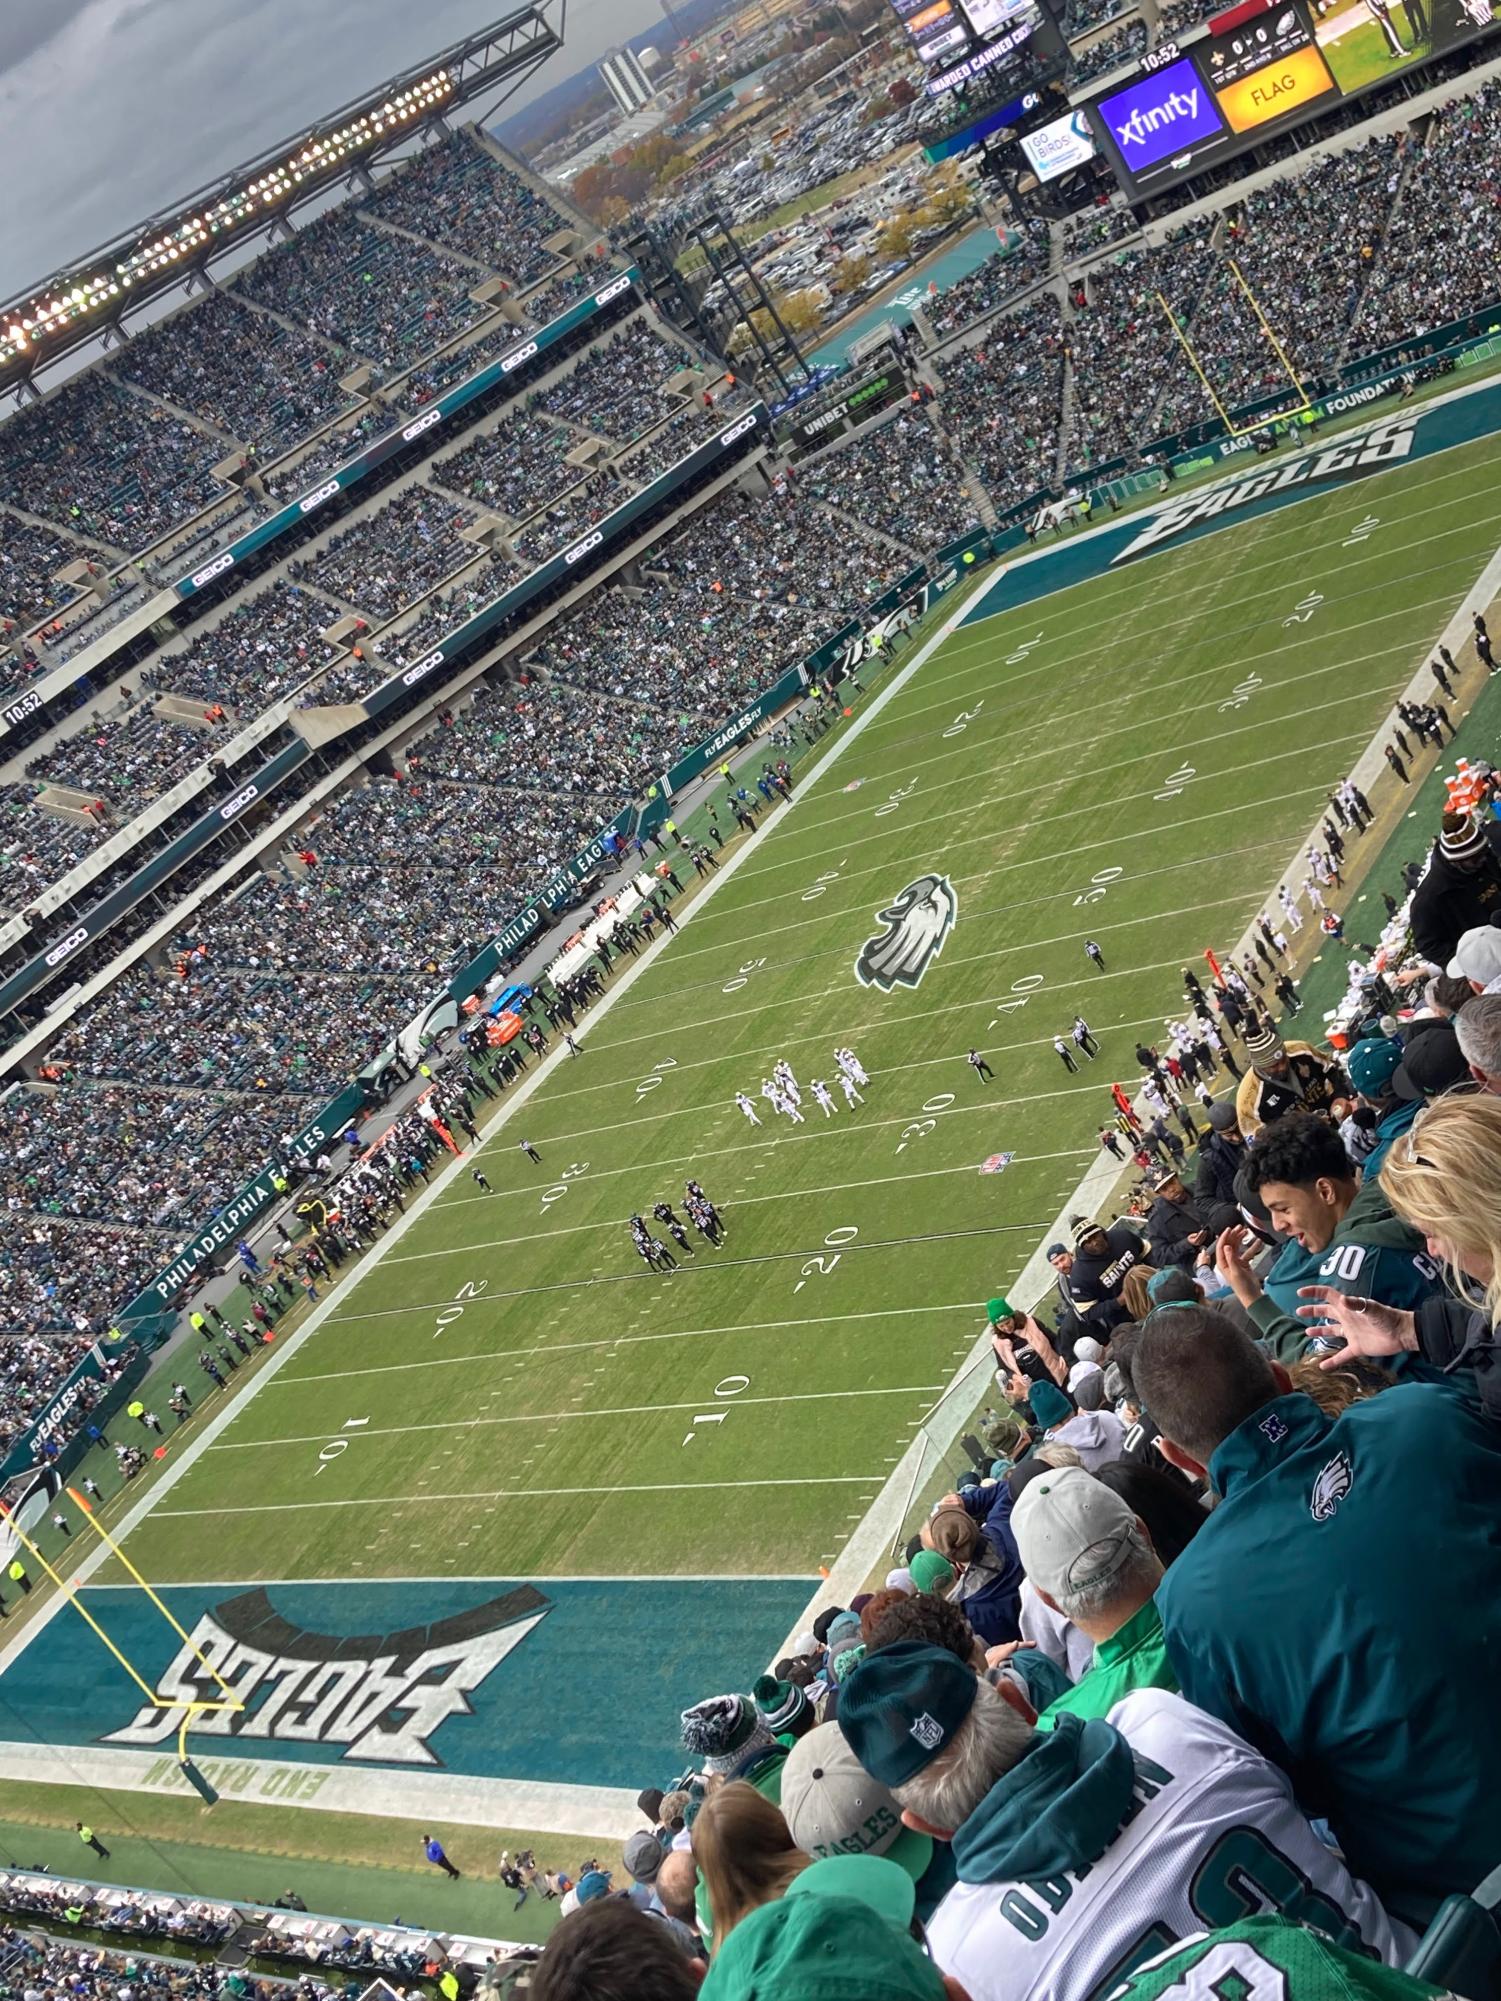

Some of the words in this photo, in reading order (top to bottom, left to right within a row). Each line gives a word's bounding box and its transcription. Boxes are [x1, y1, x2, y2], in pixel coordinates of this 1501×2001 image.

[970, 38, 1014, 72] CANNED
[1139, 43, 1181, 72] 10:52
[1231, 40, 1244, 55] 0
[1255, 26, 1268, 42] 0
[1251, 75, 1297, 107] FLAG
[1116, 88, 1199, 146] xfinity
[1032, 133, 1049, 148] GO
[595, 275, 632, 306] GEICO
[500, 342, 538, 373] GEICO
[401, 409, 442, 442] GEICO
[719, 414, 758, 447] GEICO
[802, 401, 850, 437] UNIBET
[299, 479, 341, 513] GEICO
[1109, 405, 1440, 565] EAGLES
[563, 531, 604, 566] GEICO
[1340, 516, 1381, 549] 10
[190, 553, 235, 588] GEICO
[1281, 594, 1325, 628] 20
[401, 651, 444, 686] GEICO
[4, 692, 44, 727] 10:52
[1217, 678, 1264, 713] 30
[713, 712, 754, 750] EAGLES
[219, 784, 260, 821] GEICO
[1152, 767, 1198, 802] 40
[1071, 866, 1124, 907] 50
[493, 870, 578, 958] PHILADLPHIA
[44, 926, 89, 967] GEICO
[721, 957, 768, 994] 50
[996, 974, 1045, 1015] 40
[635, 1056, 679, 1093] 40
[901, 1093, 957, 1139] 30
[541, 1161, 591, 1203] 30
[155, 1182, 271, 1300] PHILADELPHIA
[800, 1225, 859, 1277] 20
[1101, 1249, 1135, 1289] SAINTS
[433, 1278, 490, 1327] 20
[37, 1391, 80, 1442] EAGLES
[692, 1374, 751, 1427] 10
[317, 1415, 372, 1463] 10
[94, 1609, 555, 1766] EAGLES
[141, 1757, 260, 1794] RACSM
[259, 1768, 331, 1800] END
[813, 1805, 899, 1860] EAGLES
